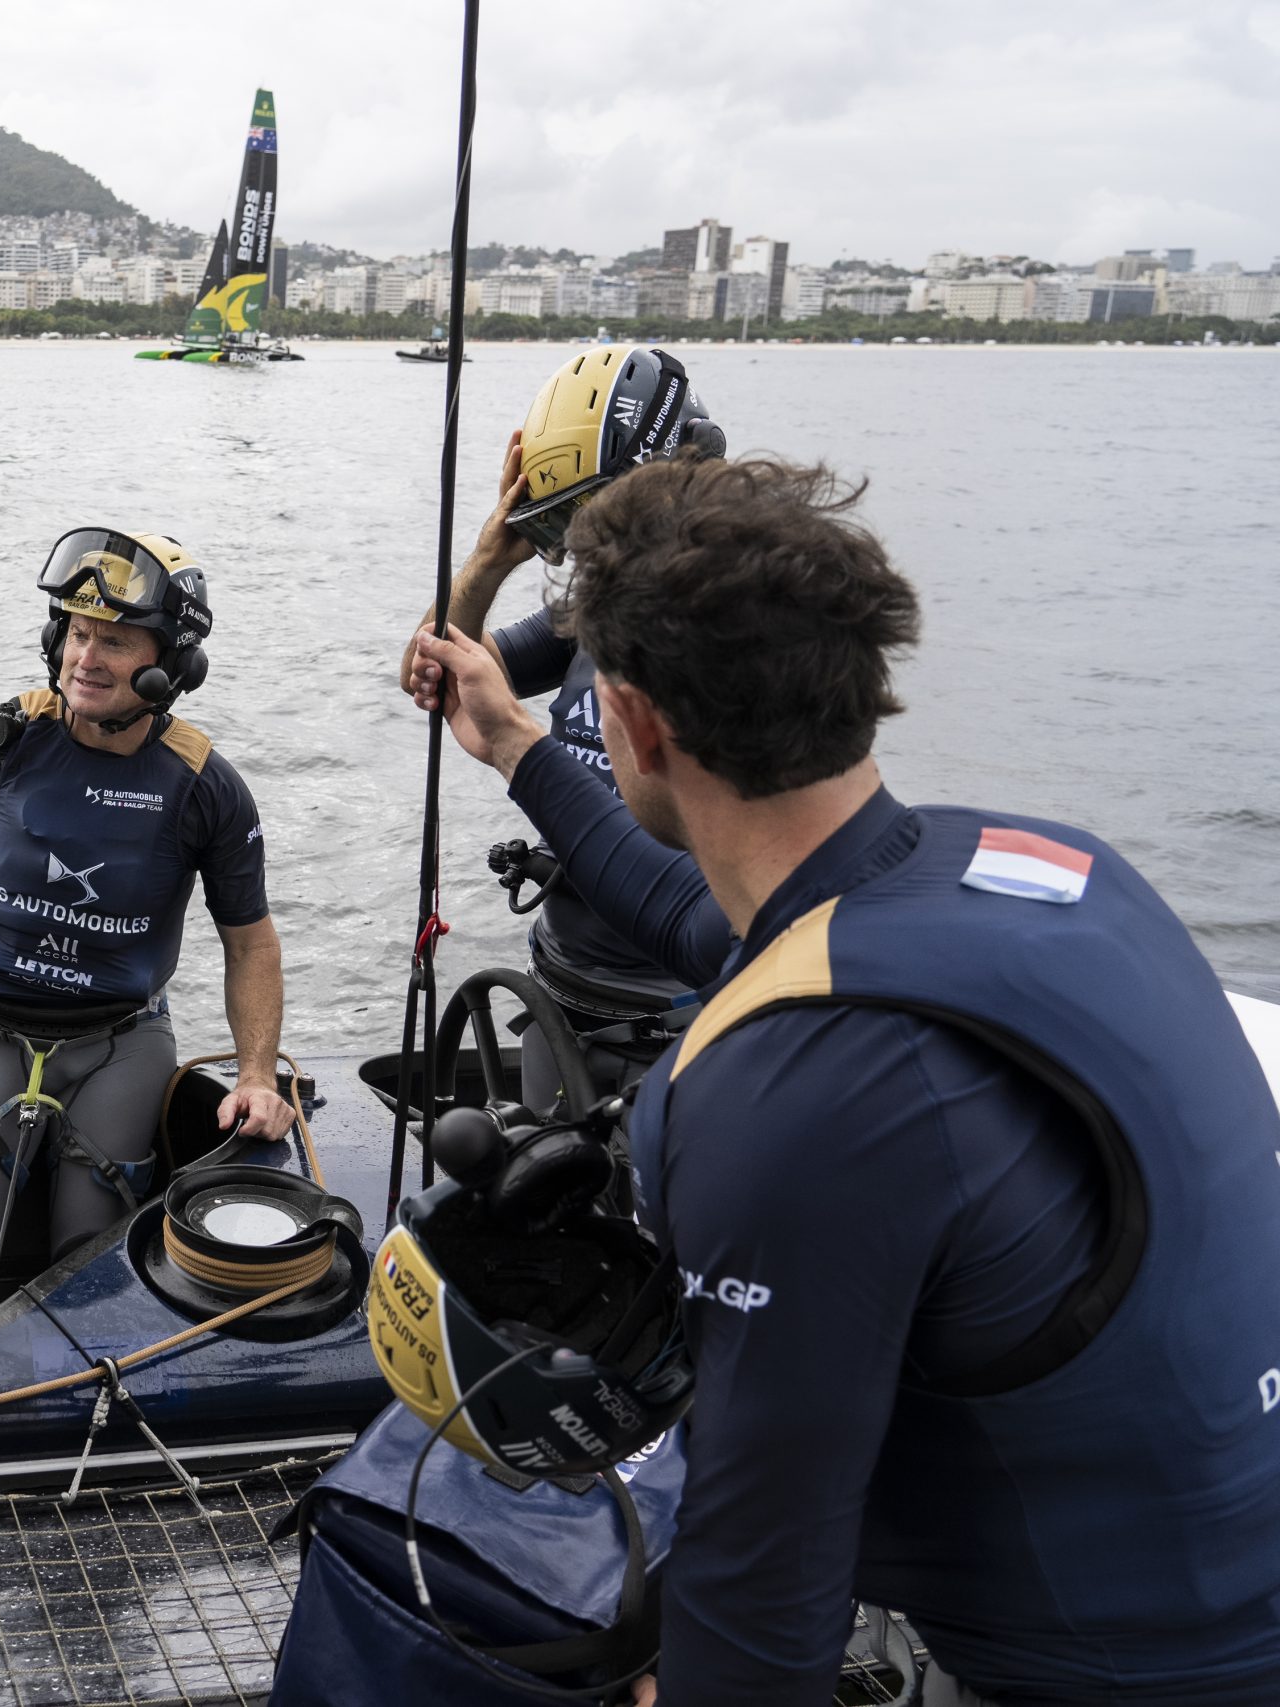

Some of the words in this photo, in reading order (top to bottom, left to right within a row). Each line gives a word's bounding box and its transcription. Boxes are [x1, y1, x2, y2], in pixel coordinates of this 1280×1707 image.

[237, 190, 260, 261] BONDS
[256, 228, 268, 263] DOWN
[229, 352, 269, 362] BONDS
[633, 400, 644, 429] ACCOR
[646, 430, 657, 444] DS
[654, 377, 679, 431] AUTOMOBILES
[89, 605, 107, 615] TEAM
[565, 725, 605, 743] ACCO
[104, 789, 114, 798] DS
[114, 791, 163, 803] AUTOMOBILES
[123, 802, 146, 810] SAILGP
[146, 804, 163, 812] TEAM
[11, 893, 151, 934] AUTOMOBILES
[14, 955, 93, 986] LEYTON
[35, 949, 79, 964] ACCOR
[394, 1271, 430, 1321] FRA
[418, 1343, 438, 1366] DS
[549, 1403, 609, 1457] LEYTON
